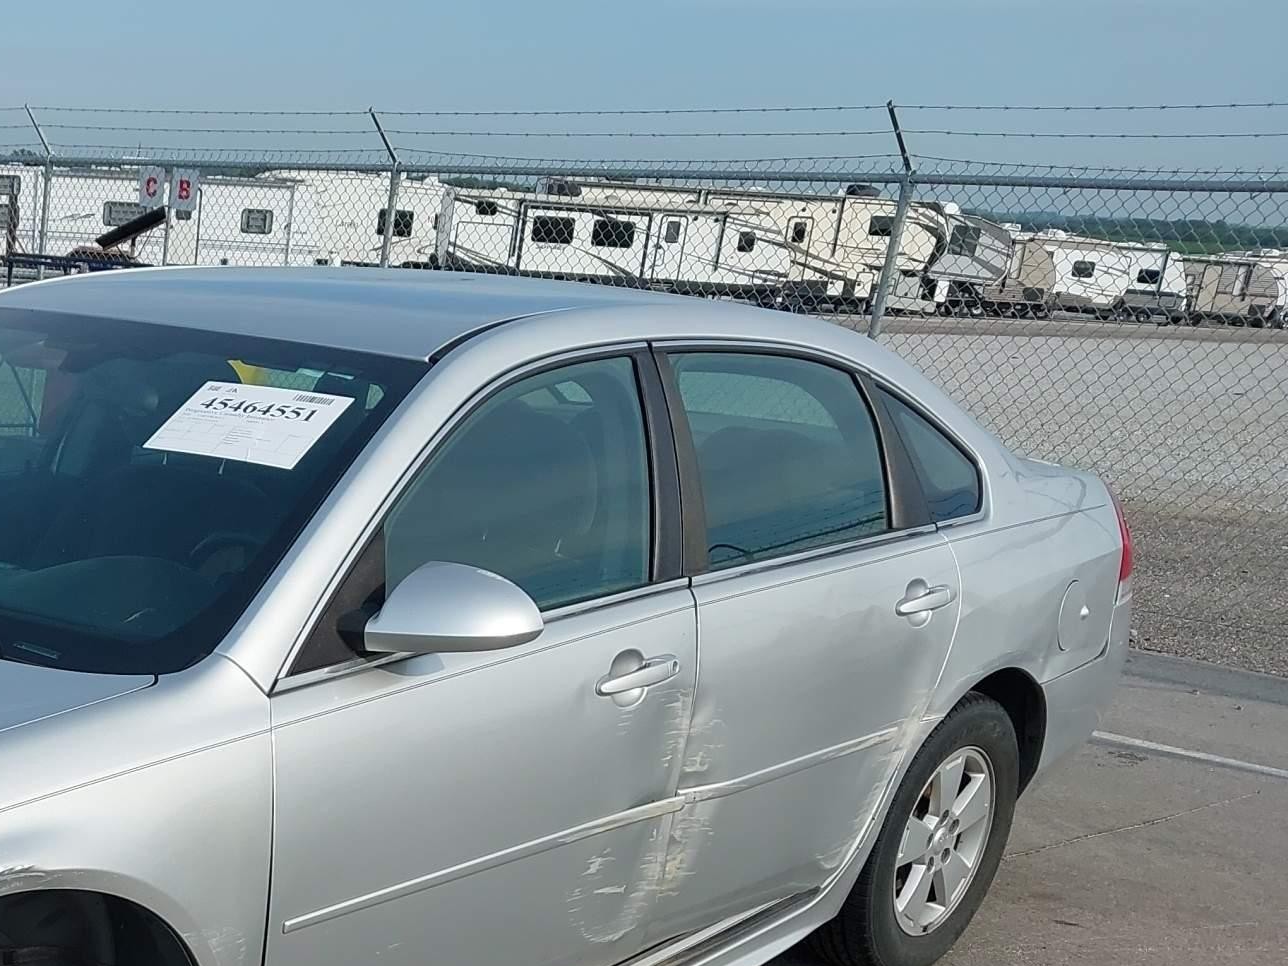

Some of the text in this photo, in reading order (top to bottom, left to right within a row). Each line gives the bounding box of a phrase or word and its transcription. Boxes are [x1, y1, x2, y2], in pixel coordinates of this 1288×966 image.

[146, 176, 158, 198] C
[178, 180, 191, 200] B
[200, 398, 318, 421] 45464551
